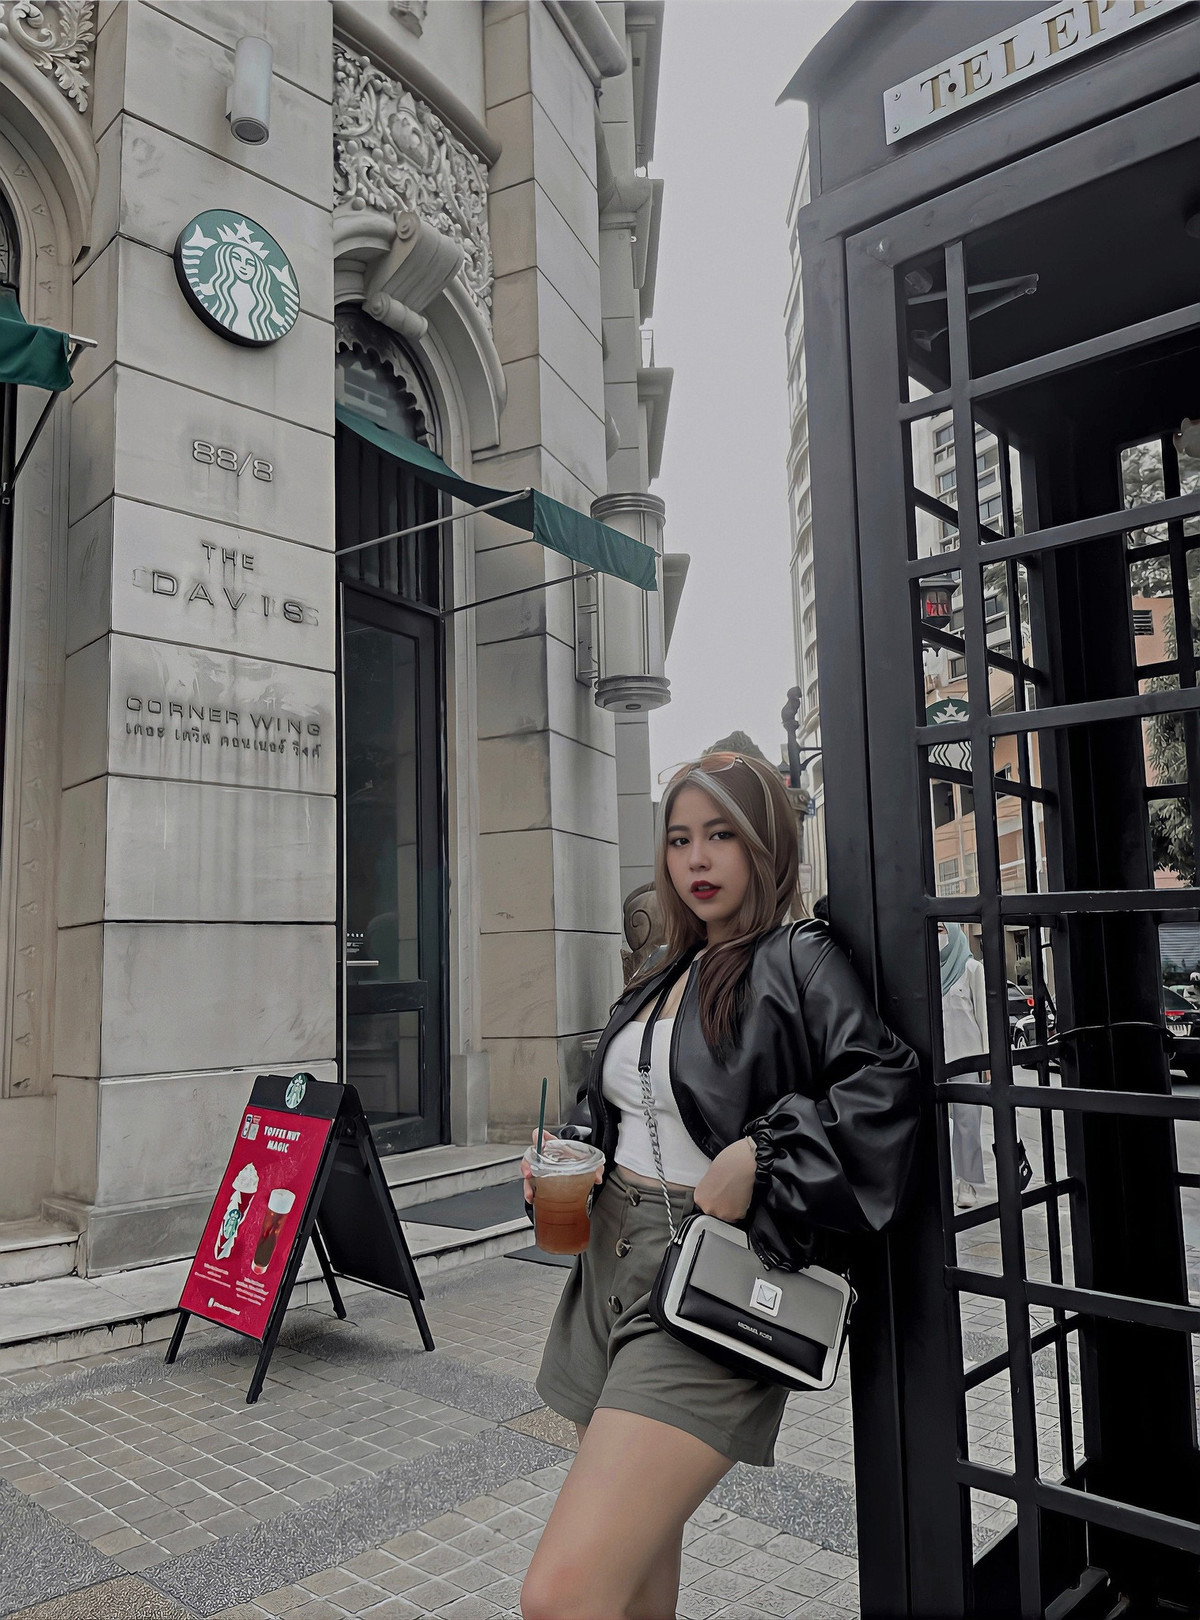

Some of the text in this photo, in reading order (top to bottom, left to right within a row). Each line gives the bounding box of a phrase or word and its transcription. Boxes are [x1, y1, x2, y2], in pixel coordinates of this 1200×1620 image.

[192, 439, 274, 483] 88/8
[201, 542, 255, 571] THE
[152, 571, 304, 624] DAVIS
[125, 697, 321, 737] CORNER WING
